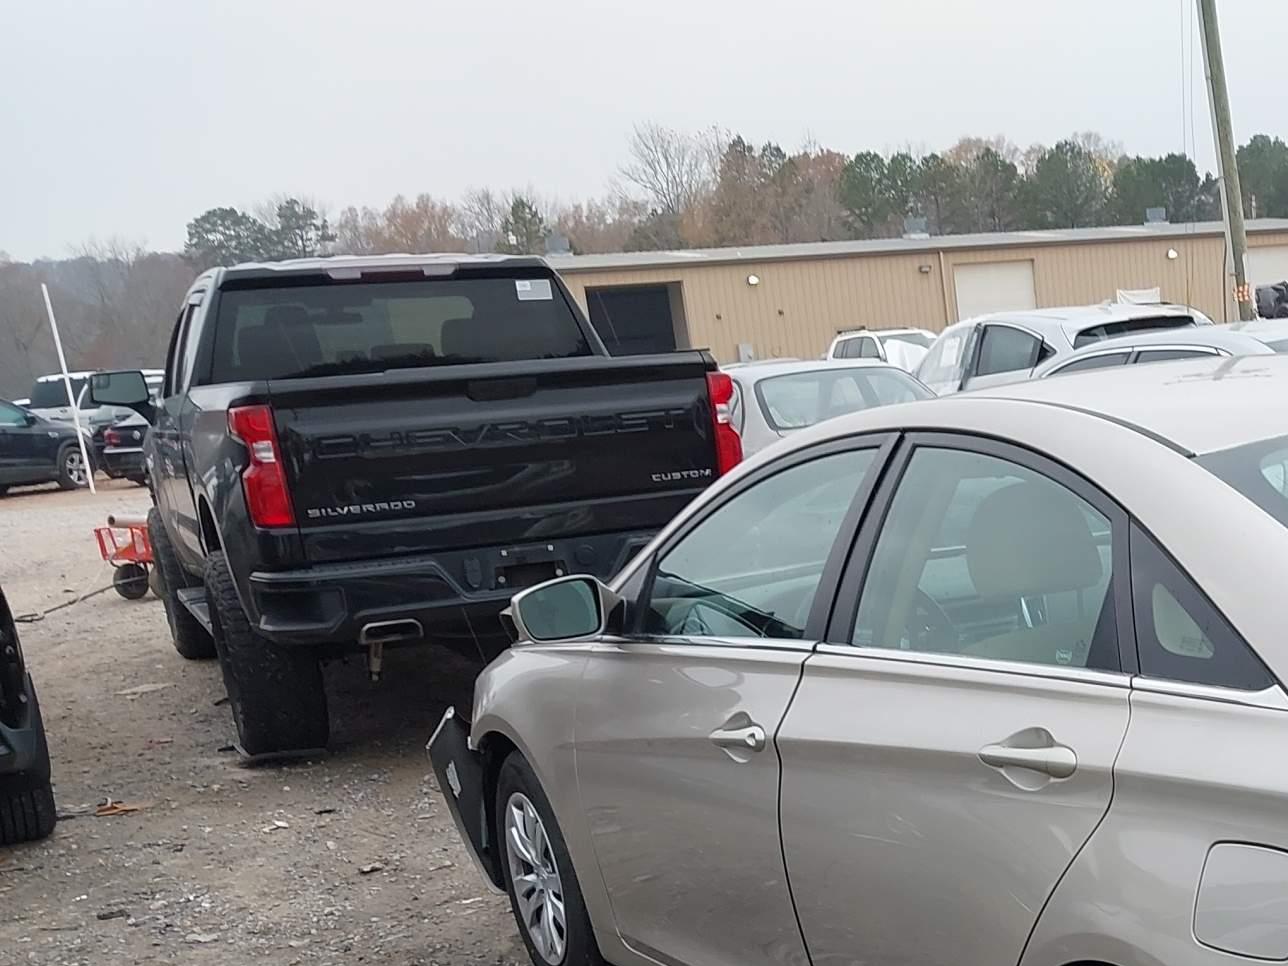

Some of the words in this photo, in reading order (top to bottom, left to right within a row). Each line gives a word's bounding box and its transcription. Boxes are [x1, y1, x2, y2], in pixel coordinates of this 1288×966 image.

[312, 407, 685, 461] CHEVROLET
[651, 468, 712, 482] CUSTOM
[307, 500, 416, 518] SILVERADO
